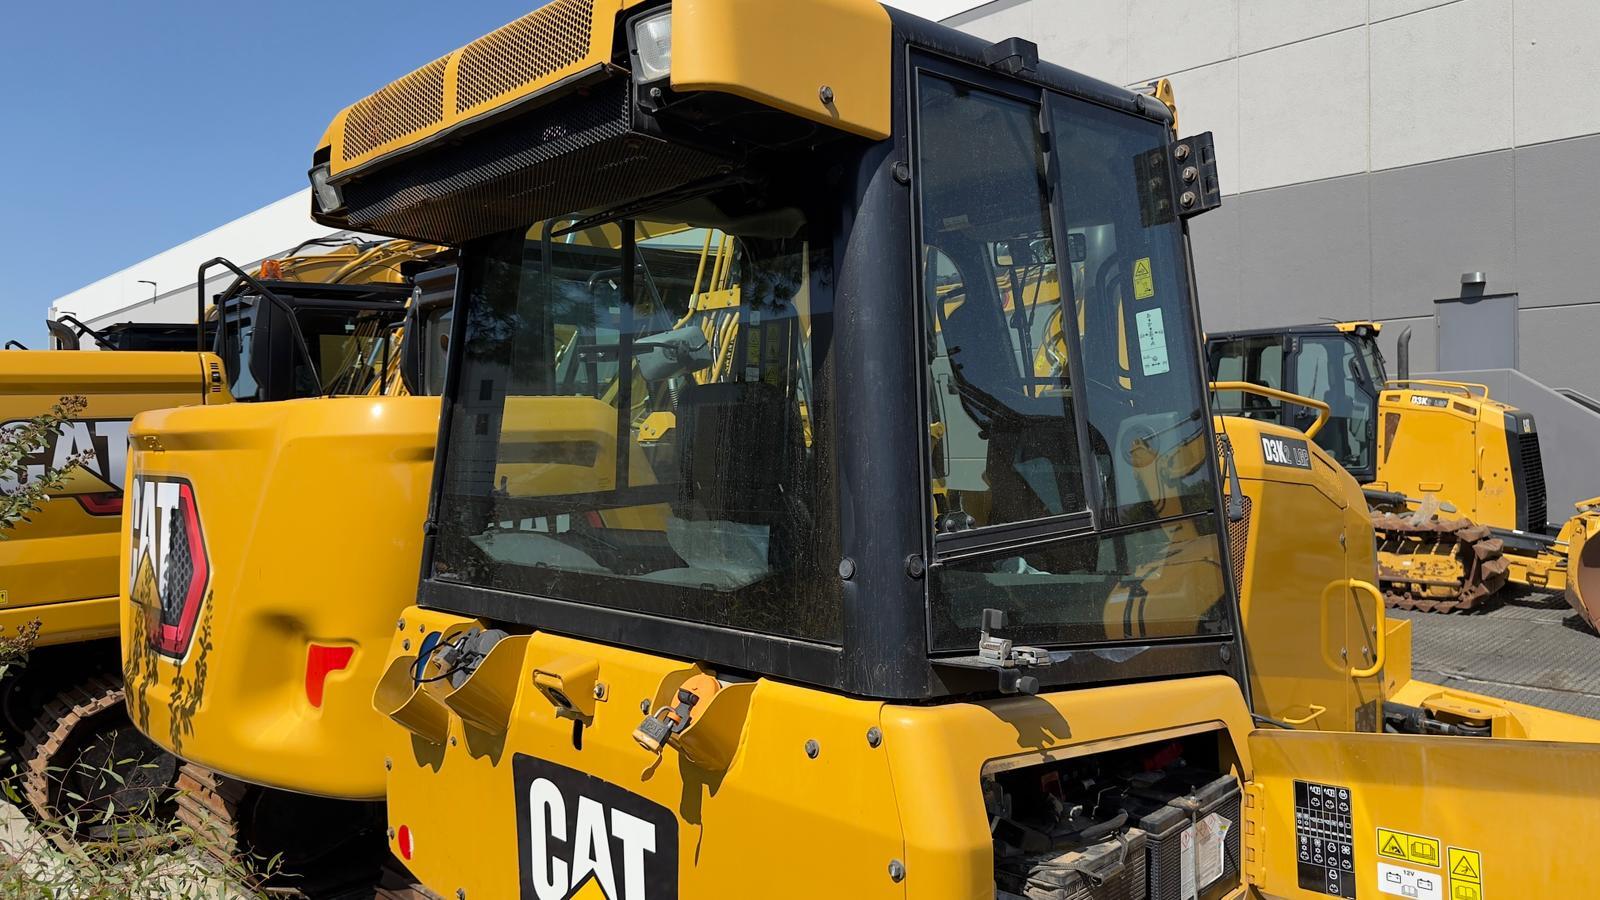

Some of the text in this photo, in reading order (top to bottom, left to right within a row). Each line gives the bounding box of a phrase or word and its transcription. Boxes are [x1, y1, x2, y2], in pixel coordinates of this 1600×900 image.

[1262, 438, 1292, 464] D3K2
[130, 478, 181, 611] CAT
[529, 777, 656, 900] CAT
